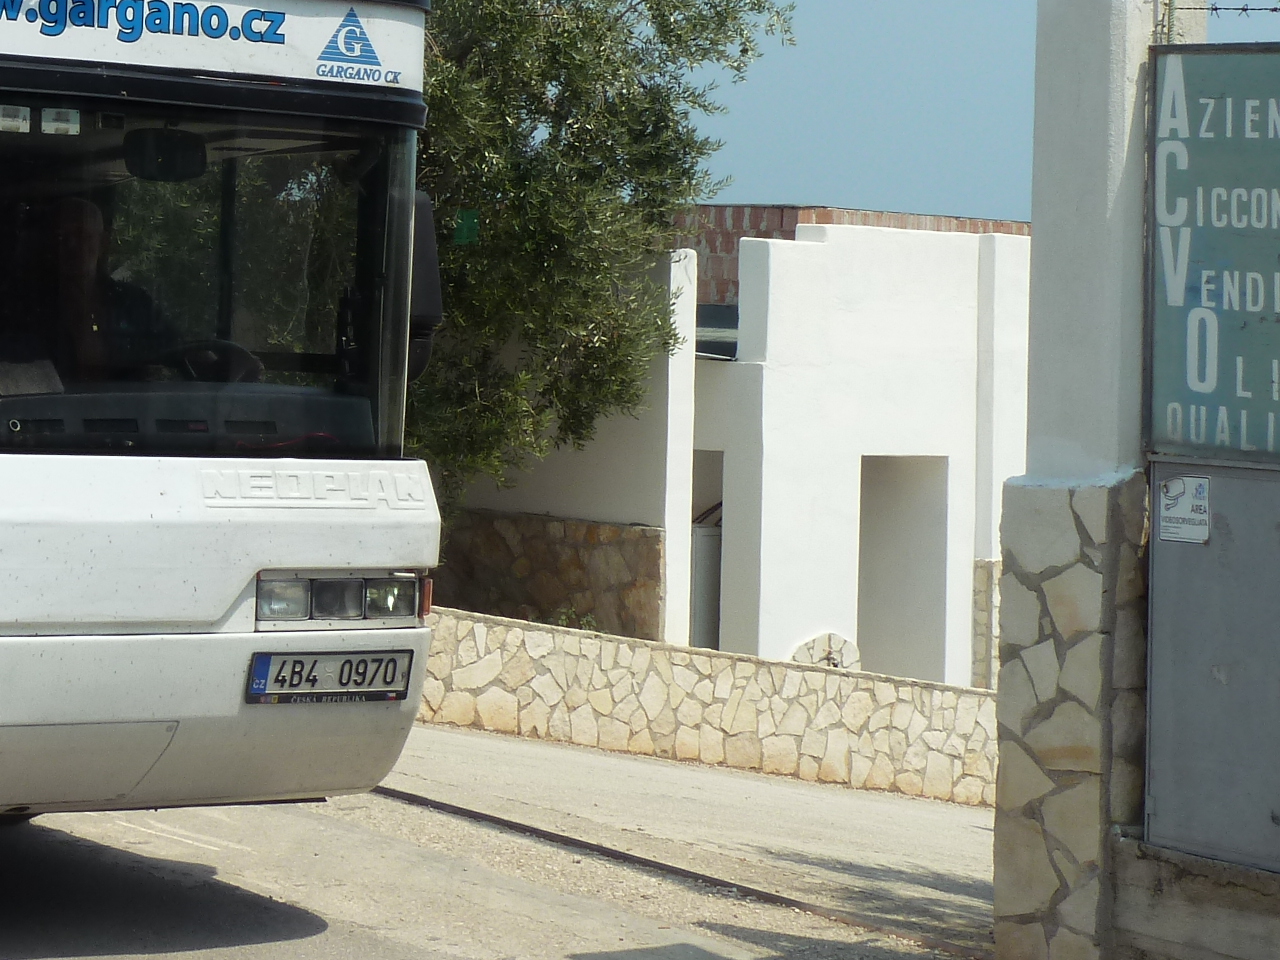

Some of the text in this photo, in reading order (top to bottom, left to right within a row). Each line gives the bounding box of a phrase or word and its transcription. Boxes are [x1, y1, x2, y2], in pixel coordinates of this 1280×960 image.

[316, 63, 402, 85] GARGANO CK
[200, 469, 426, 509] NEOPLAN
[252, 678, 266, 689] CZ
[273, 657, 398, 689] 4B4 0970
[321, 694, 367, 704] REPUBLIKA
